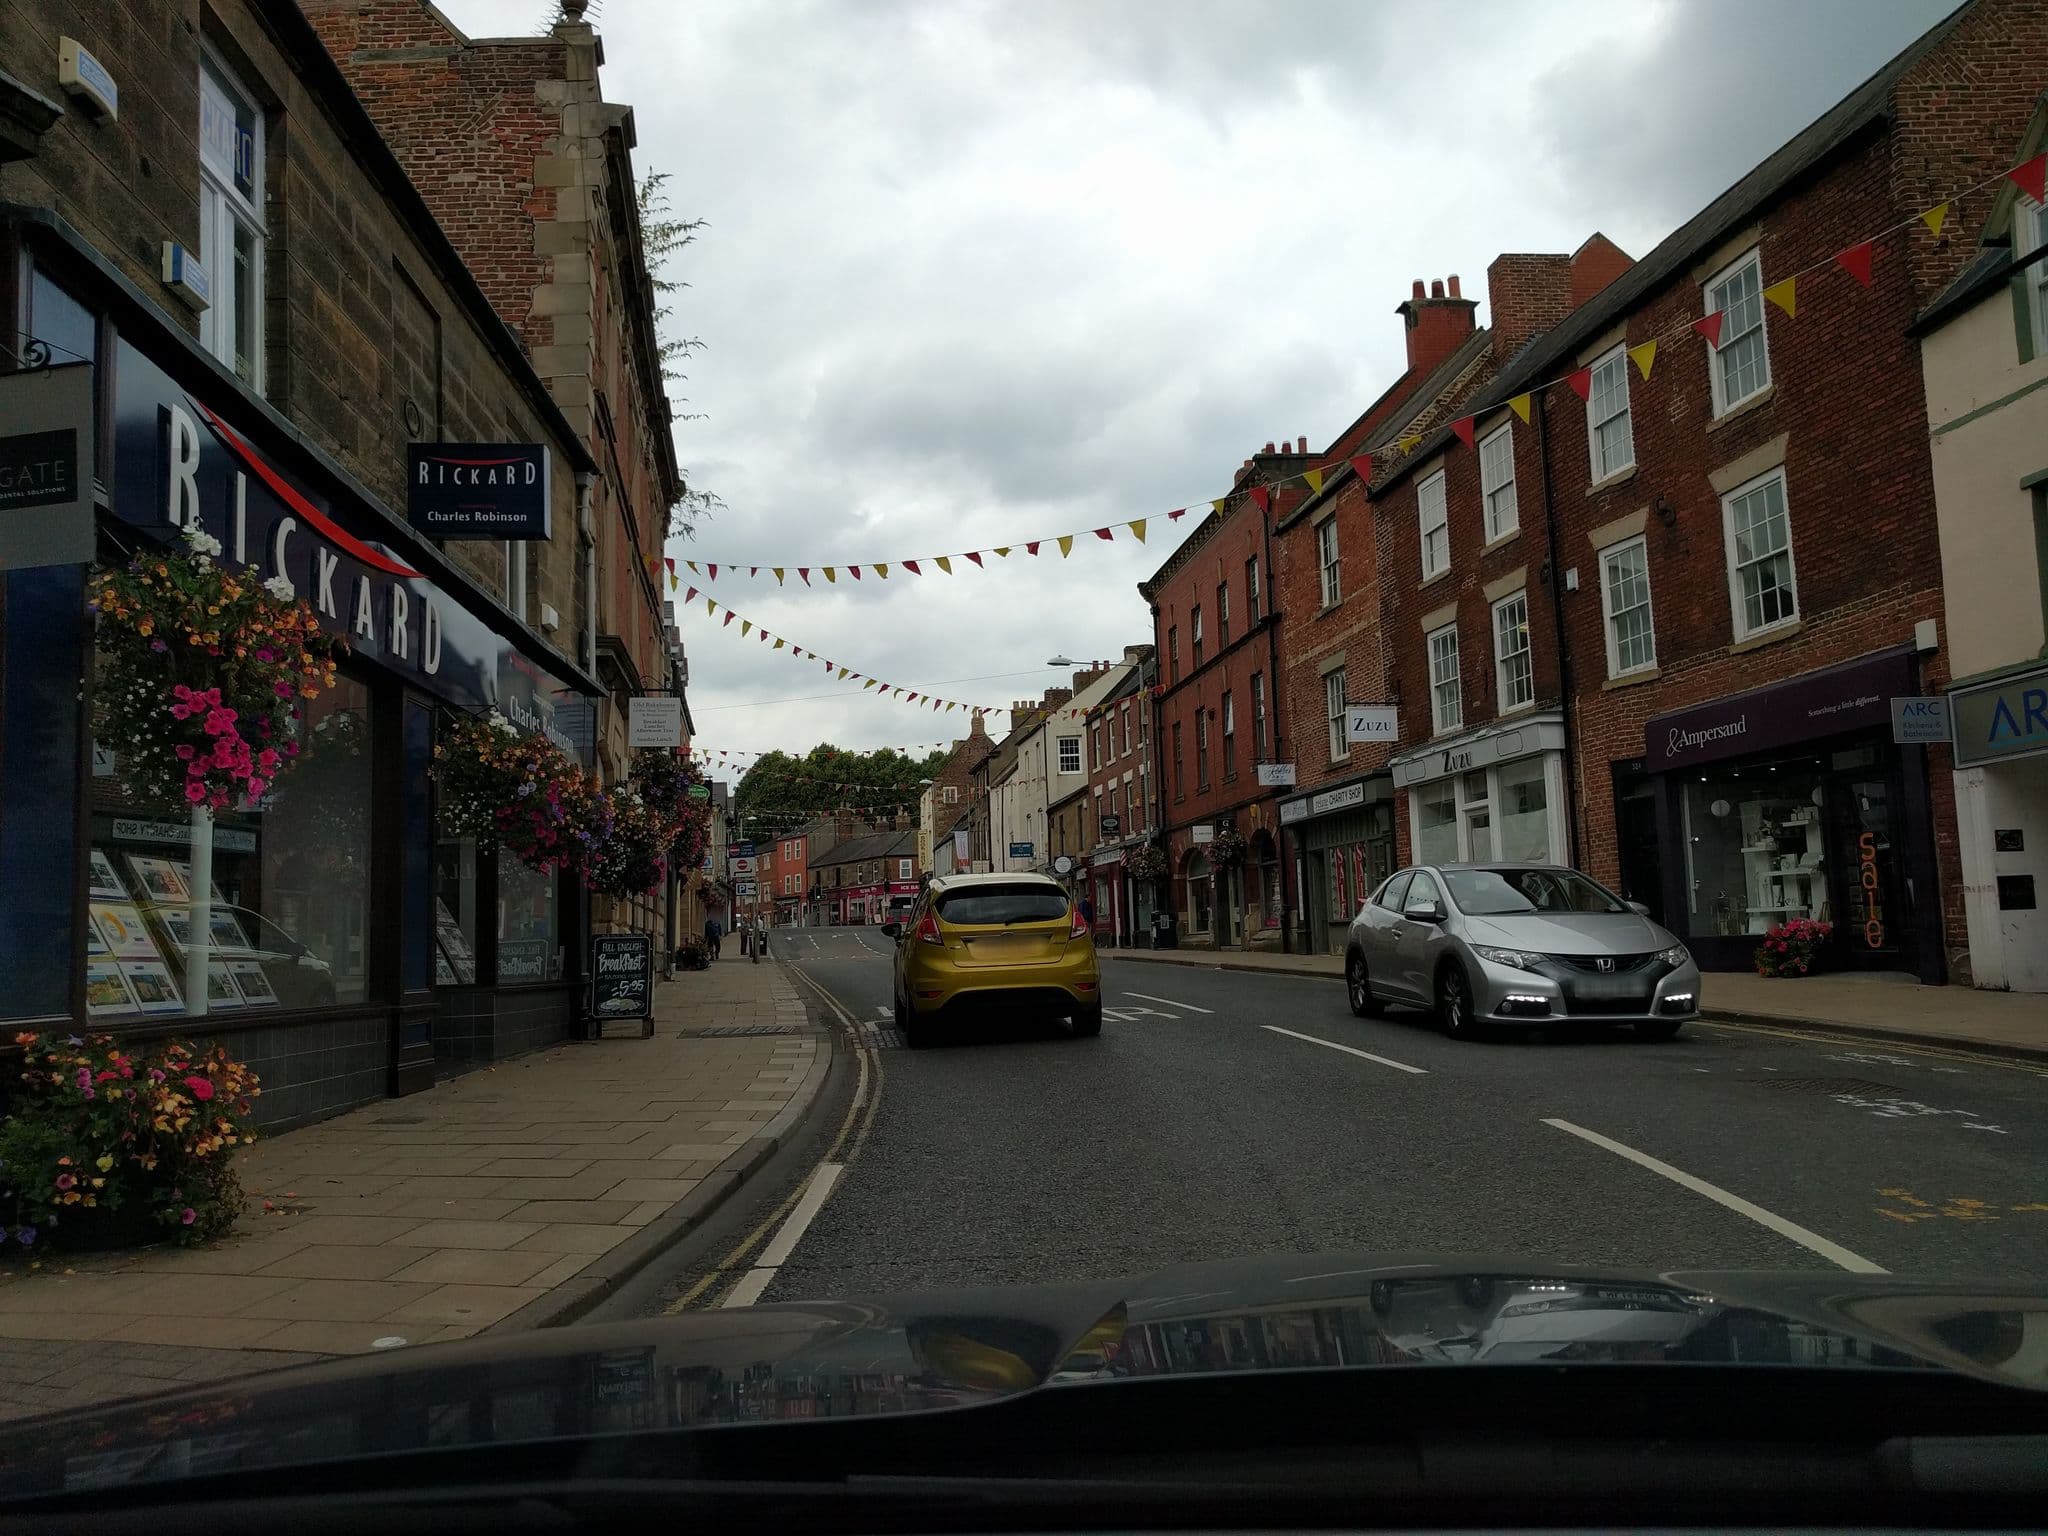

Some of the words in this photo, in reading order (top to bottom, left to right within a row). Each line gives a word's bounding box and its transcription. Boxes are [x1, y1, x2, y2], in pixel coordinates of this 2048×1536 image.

[419, 460, 536, 485] RICKARD
[427, 510, 471, 522] Charles
[474, 511, 528, 522] Robinson
[168, 403, 441, 677] RICKARD
[1902, 701, 1941, 716] ARC
[1329, 790, 1348, 805] CHARITY
[1349, 787, 1362, 800] SHOP
[1336, 847, 1347, 920] SALE
[602, 942, 614, 952] FULL
[598, 953, 646, 973] Breakfast
